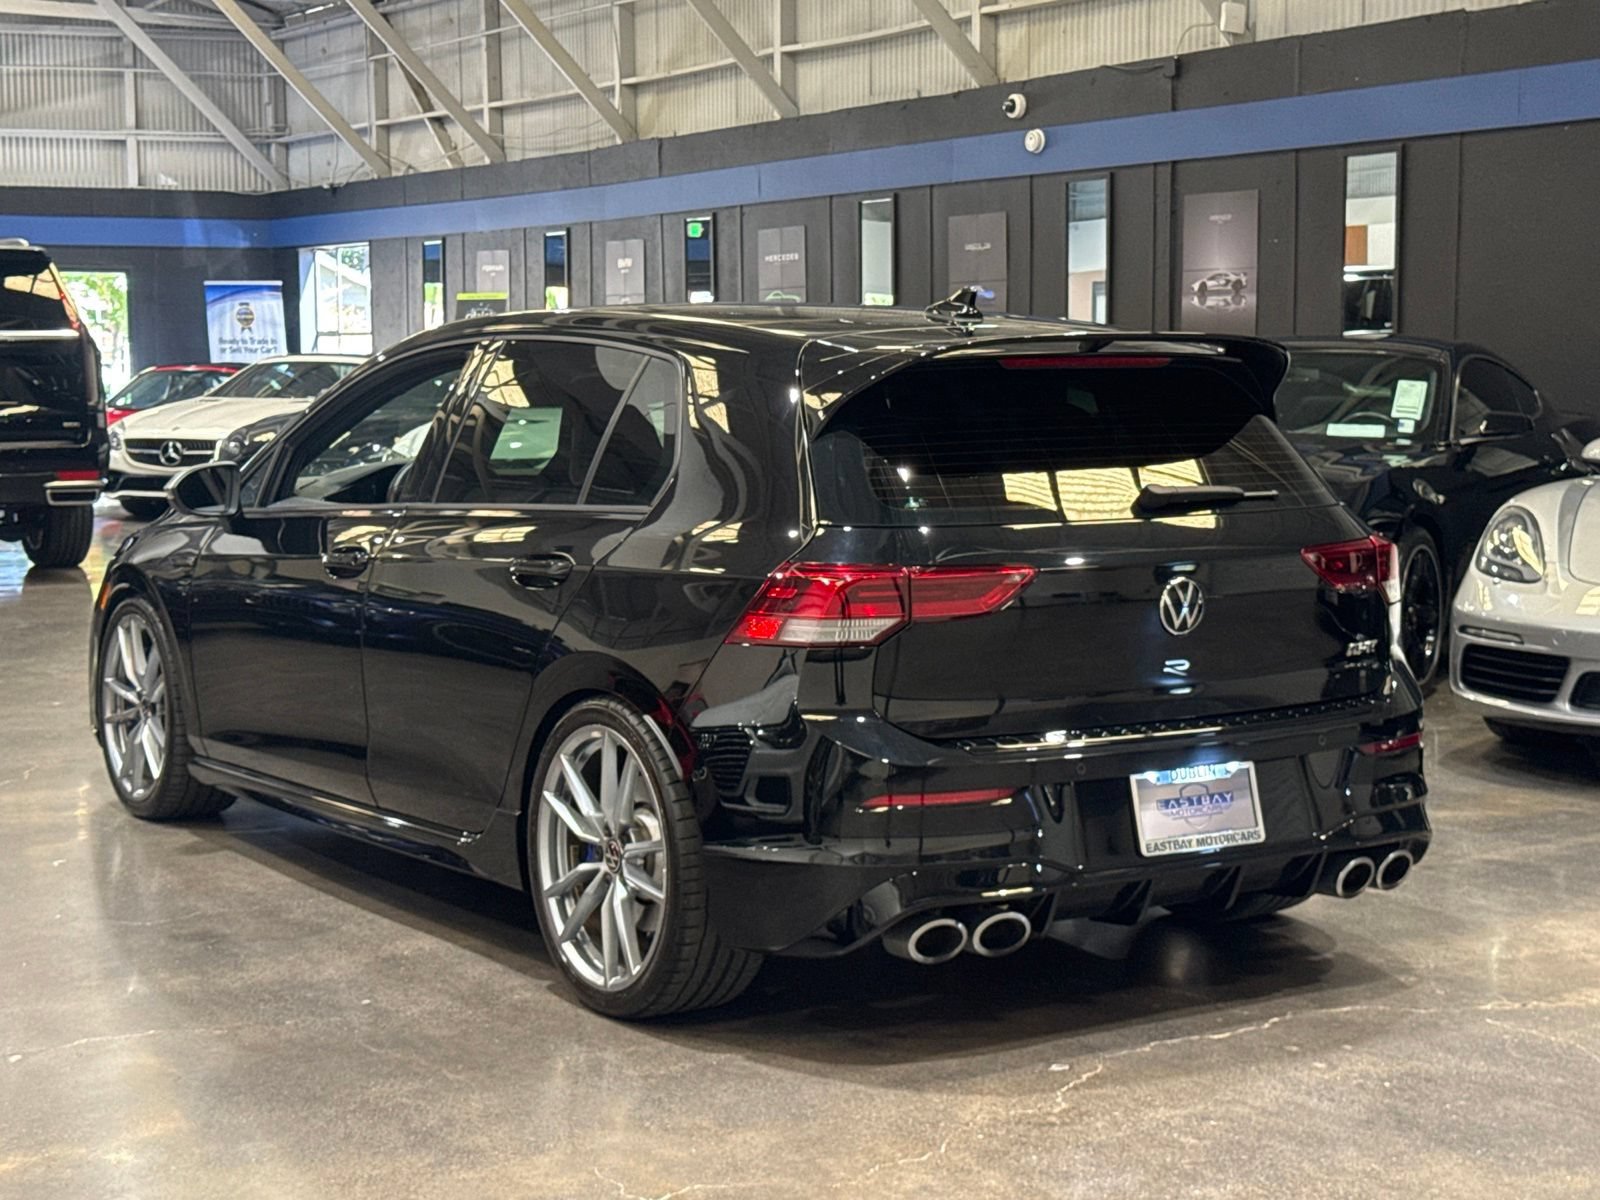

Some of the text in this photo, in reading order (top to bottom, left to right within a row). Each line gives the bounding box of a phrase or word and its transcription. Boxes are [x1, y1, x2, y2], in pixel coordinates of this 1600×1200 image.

[764, 252, 799, 262] MERCEDES
[218, 337, 240, 346] Ready
[249, 337, 269, 345] Trade
[229, 346, 242, 354] Sell
[244, 346, 258, 354] Your
[260, 346, 277, 354] Car?
[1170, 765, 1215, 780] DUBLIN
[1157, 792, 1232, 811] EASTBAY
[1169, 804, 1222, 817] MOTORCARS
[1195, 830, 1261, 848] MOTORCARS
[1145, 839, 1193, 854] EASTBAY
